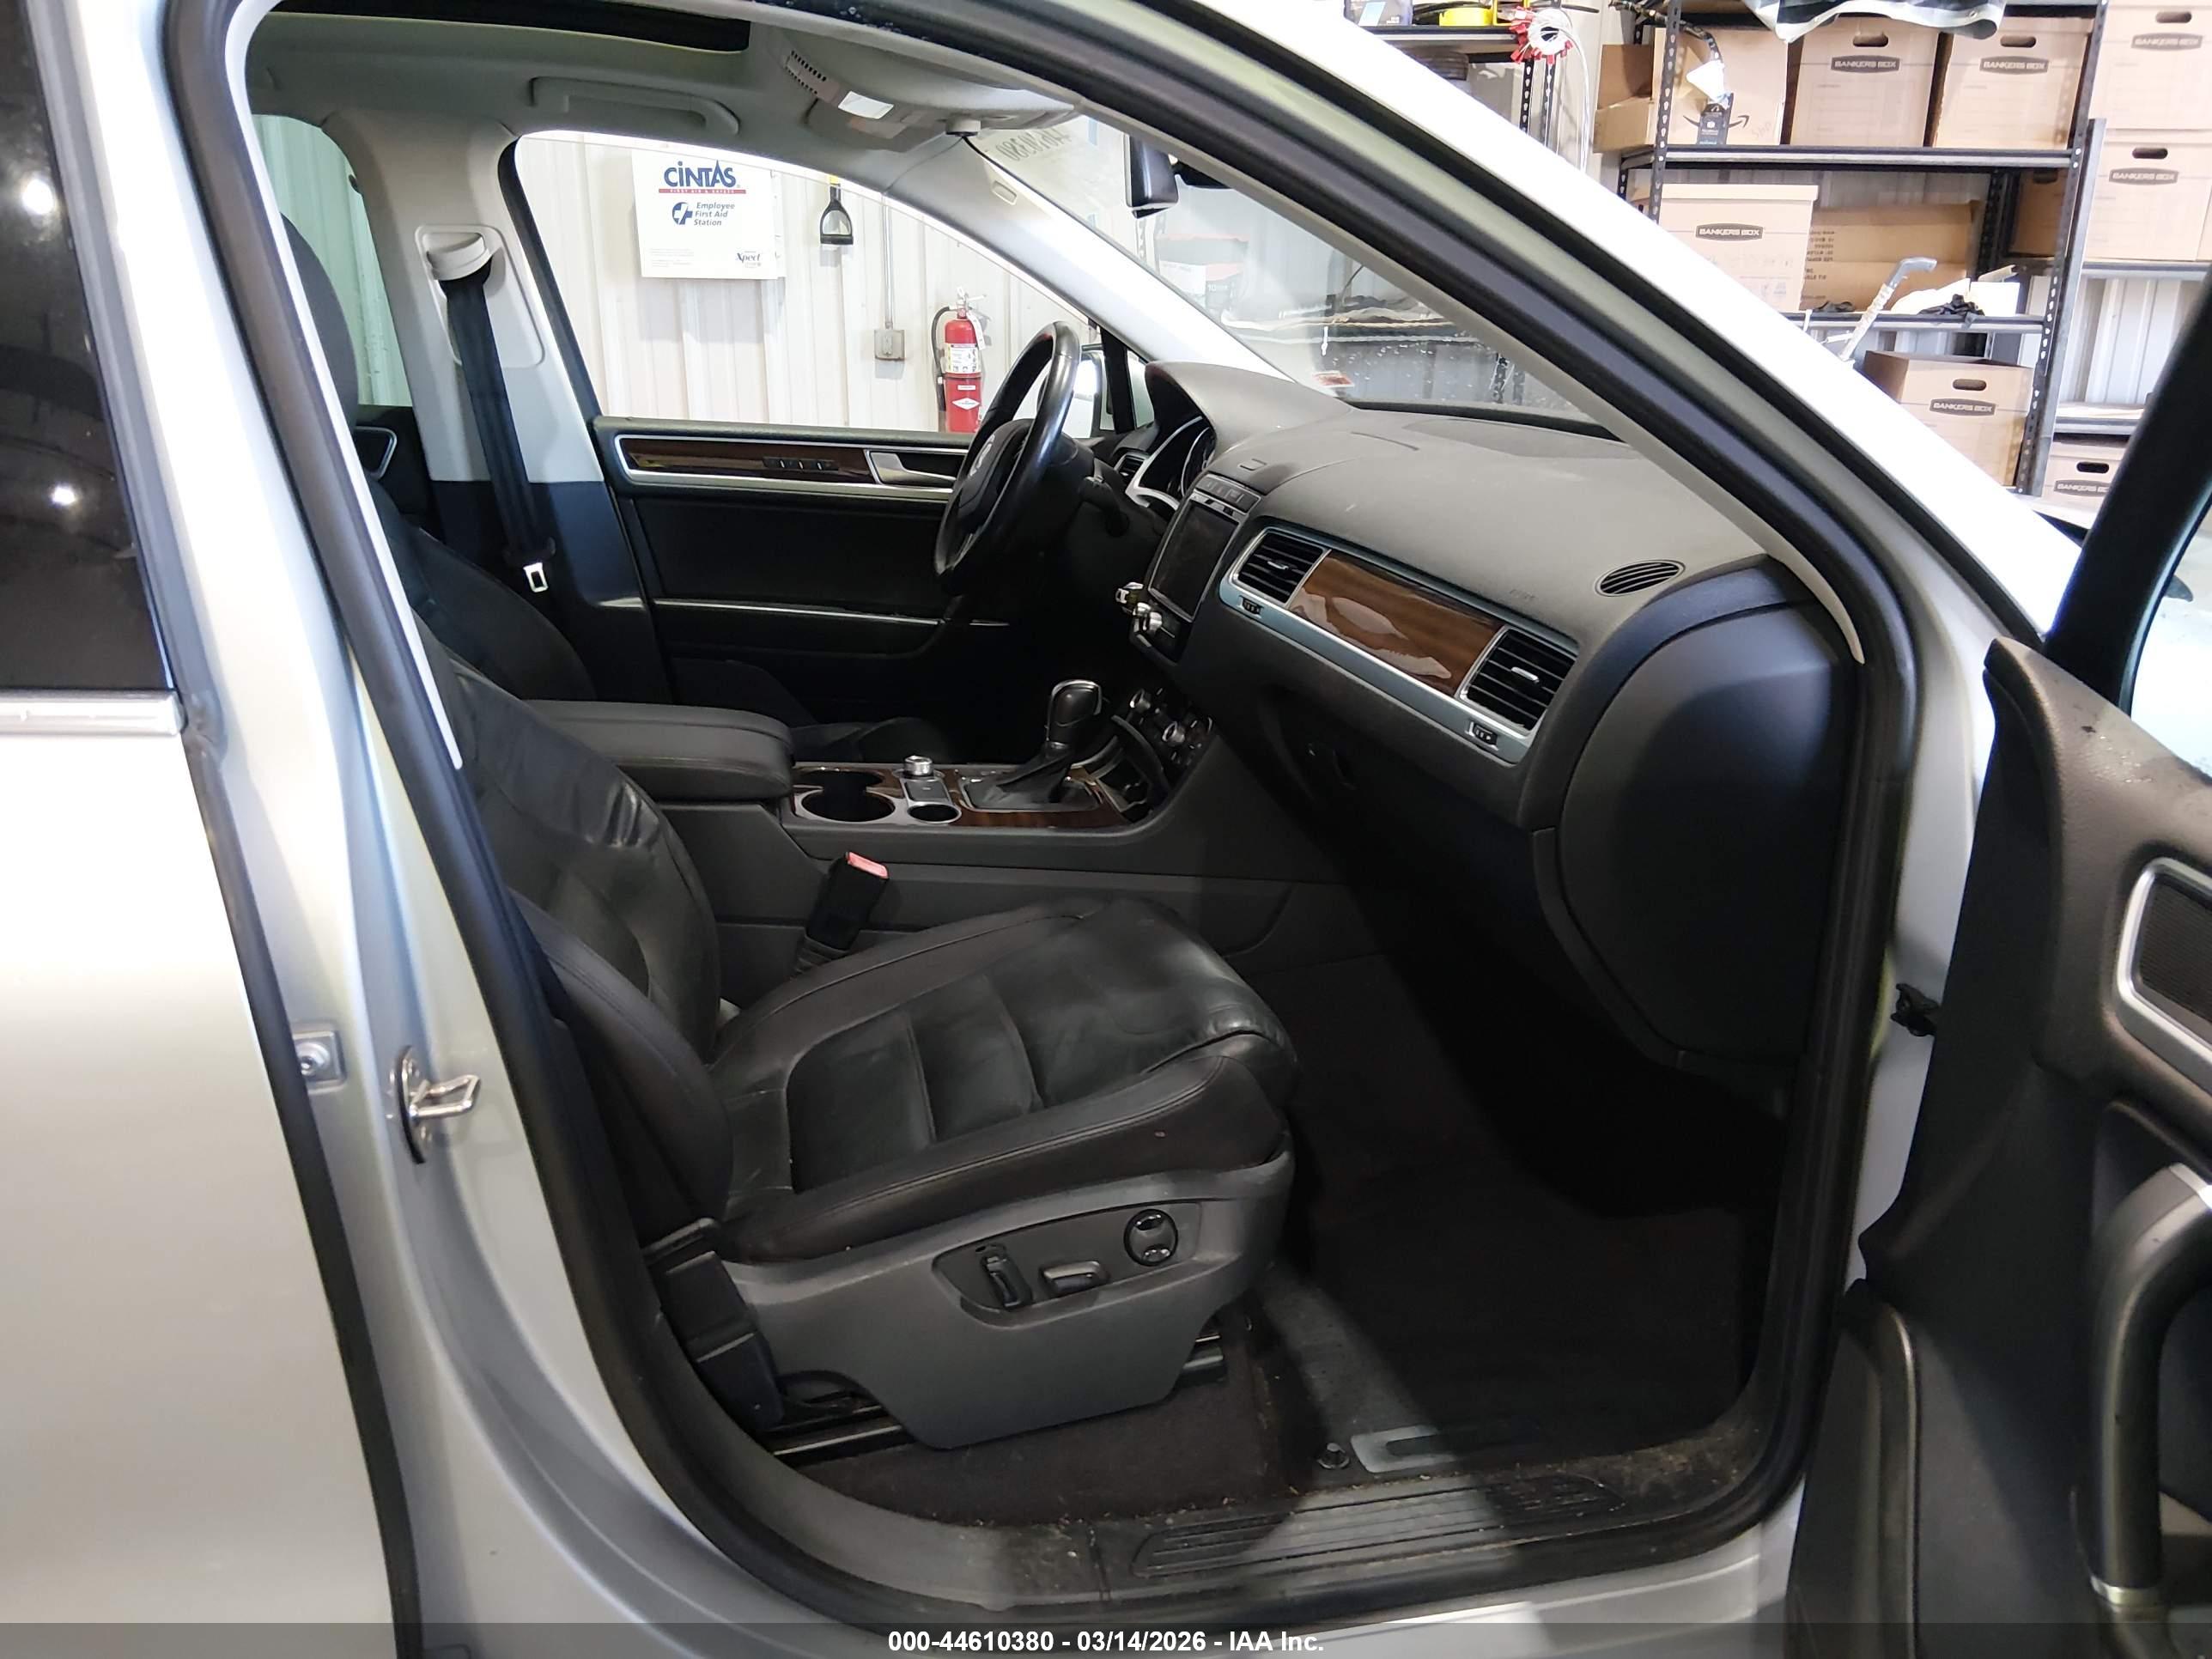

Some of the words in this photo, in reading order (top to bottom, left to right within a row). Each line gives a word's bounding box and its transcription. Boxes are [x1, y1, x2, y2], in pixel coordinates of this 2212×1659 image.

[2112, 172, 2155, 180] BANKERS
[696, 202, 736, 212] Employee
[1933, 402, 1973, 410] BANKERS
